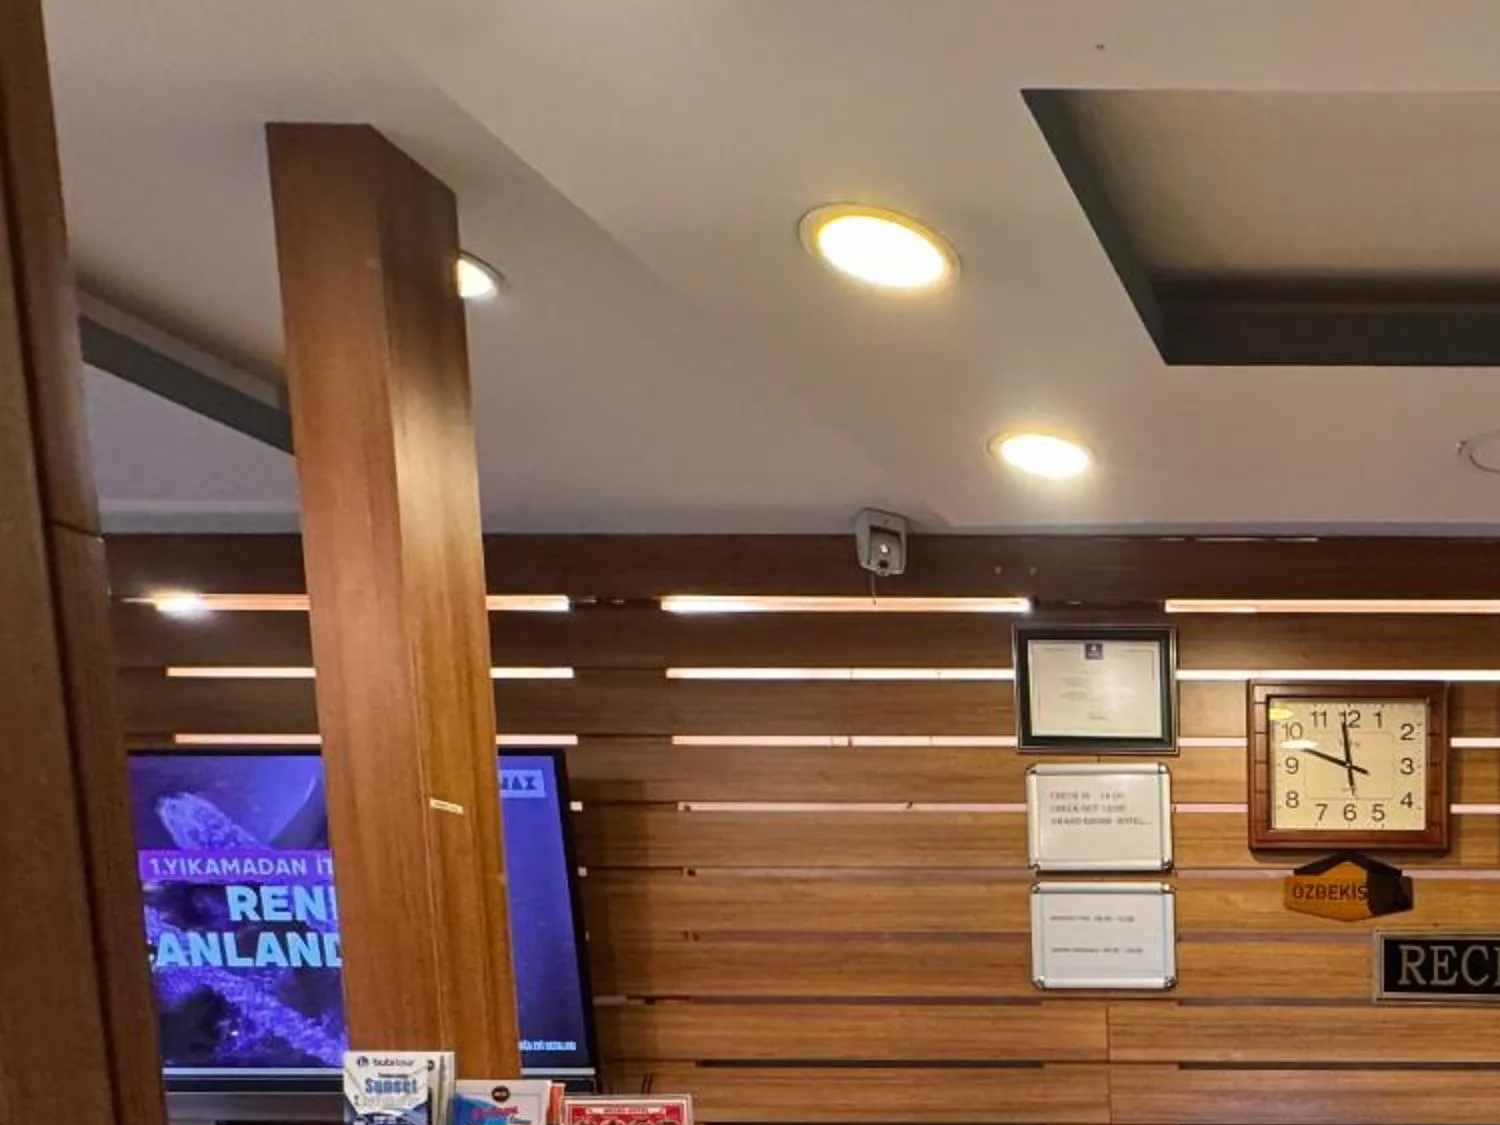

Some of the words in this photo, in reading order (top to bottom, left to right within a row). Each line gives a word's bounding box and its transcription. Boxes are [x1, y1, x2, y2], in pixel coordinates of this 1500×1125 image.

[1310, 711, 1328, 728] 11
[1374, 711, 1384, 728] 1
[1281, 722, 1303, 740] 10
[1400, 723, 1415, 741] 2
[1285, 757, 1299, 774] 9
[1400, 758, 1415, 775] 3
[1285, 791, 1299, 808] 8
[1400, 792, 1414, 809] 4
[1315, 804, 1328, 821] 7
[1343, 804, 1357, 821] 6
[1371, 804, 1385, 822] 5
[150, 857, 307, 876] 1.YIKAMADAN
